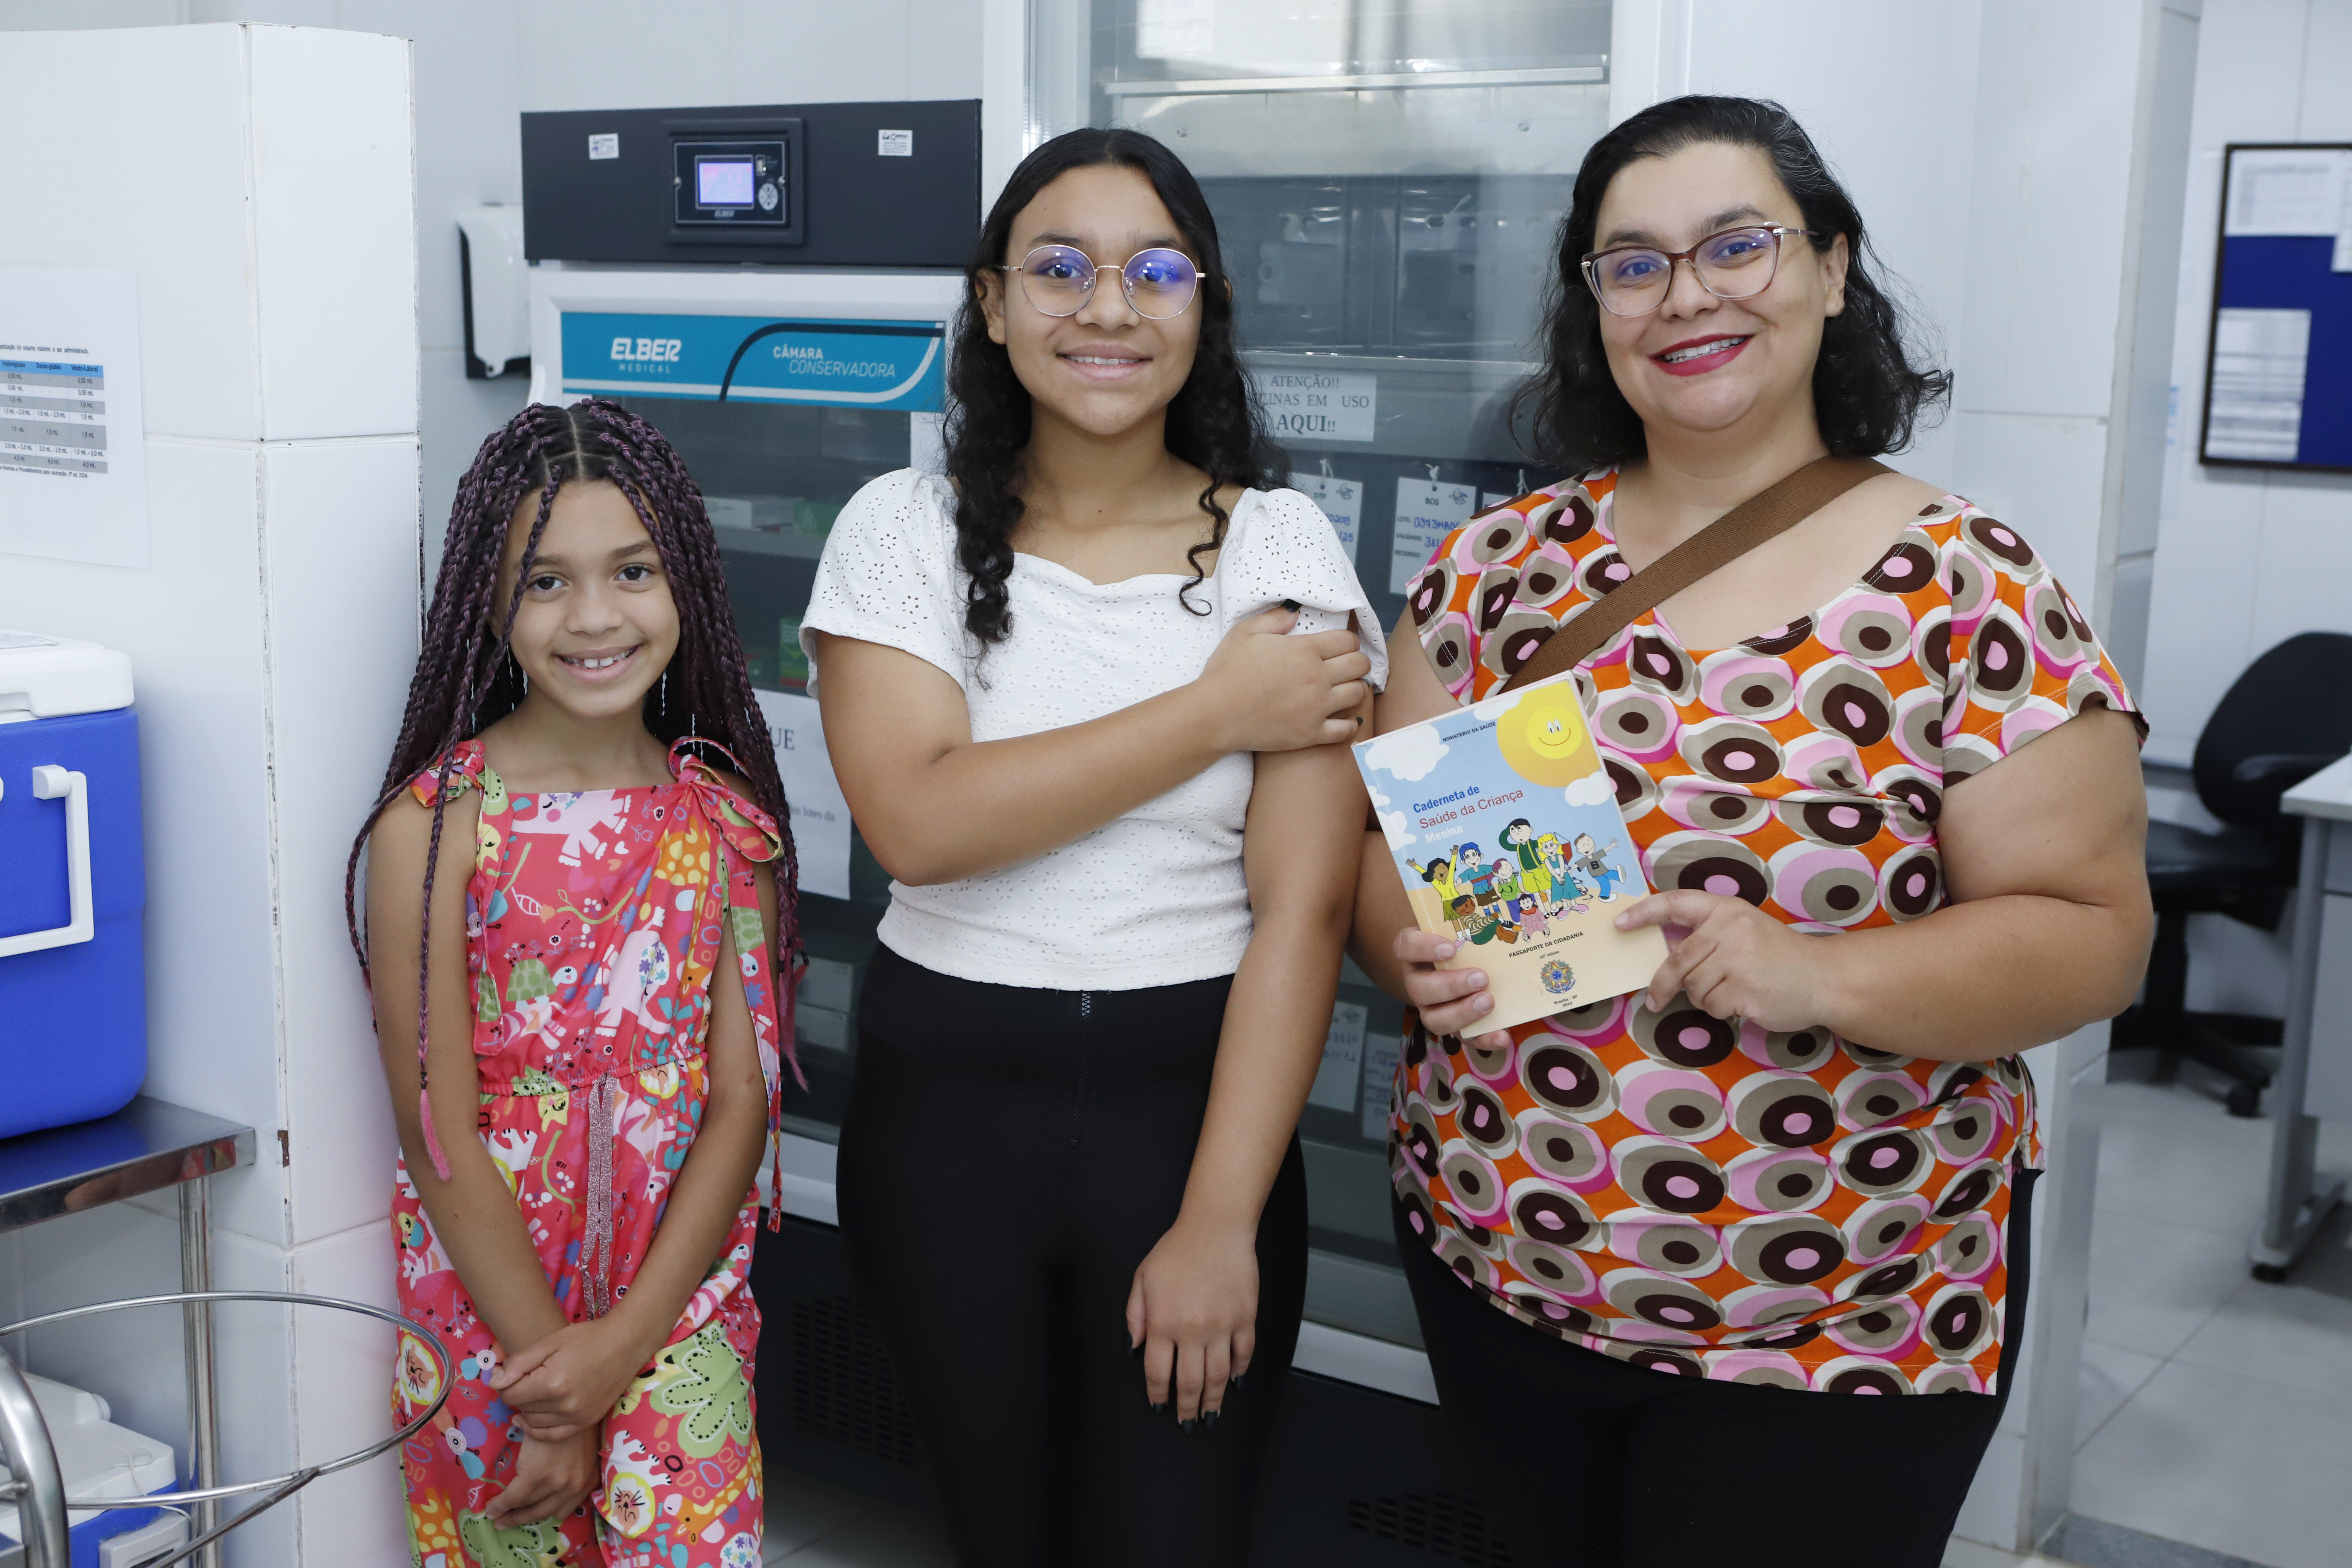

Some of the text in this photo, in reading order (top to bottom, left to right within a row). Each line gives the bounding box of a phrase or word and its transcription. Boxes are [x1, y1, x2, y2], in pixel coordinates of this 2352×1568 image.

[611, 337, 682, 362] ELBER
[773, 343, 824, 359] CÂMARA
[619, 363, 671, 374] MEDICAL
[789, 359, 896, 378] CONSERVADORA
[1270, 374, 1339, 390] ATENÇÃO!!
[1262, 393, 1369, 408] CINAS EM USO
[1276, 414, 1335, 434] AQUI!!
[1442, 730, 1471, 742] MINISTÉRIO
[1479, 721, 1496, 730] SAÚDE
[1413, 786, 1480, 813] Caderneta de
[1419, 790, 1524, 828] Saúde da Criança
[1424, 825, 1464, 844] Menina
[1590, 861, 1600, 870] B
[1509, 944, 1544, 957] PASSAPORTE
[1554, 931, 1584, 944] CIDADANIA
